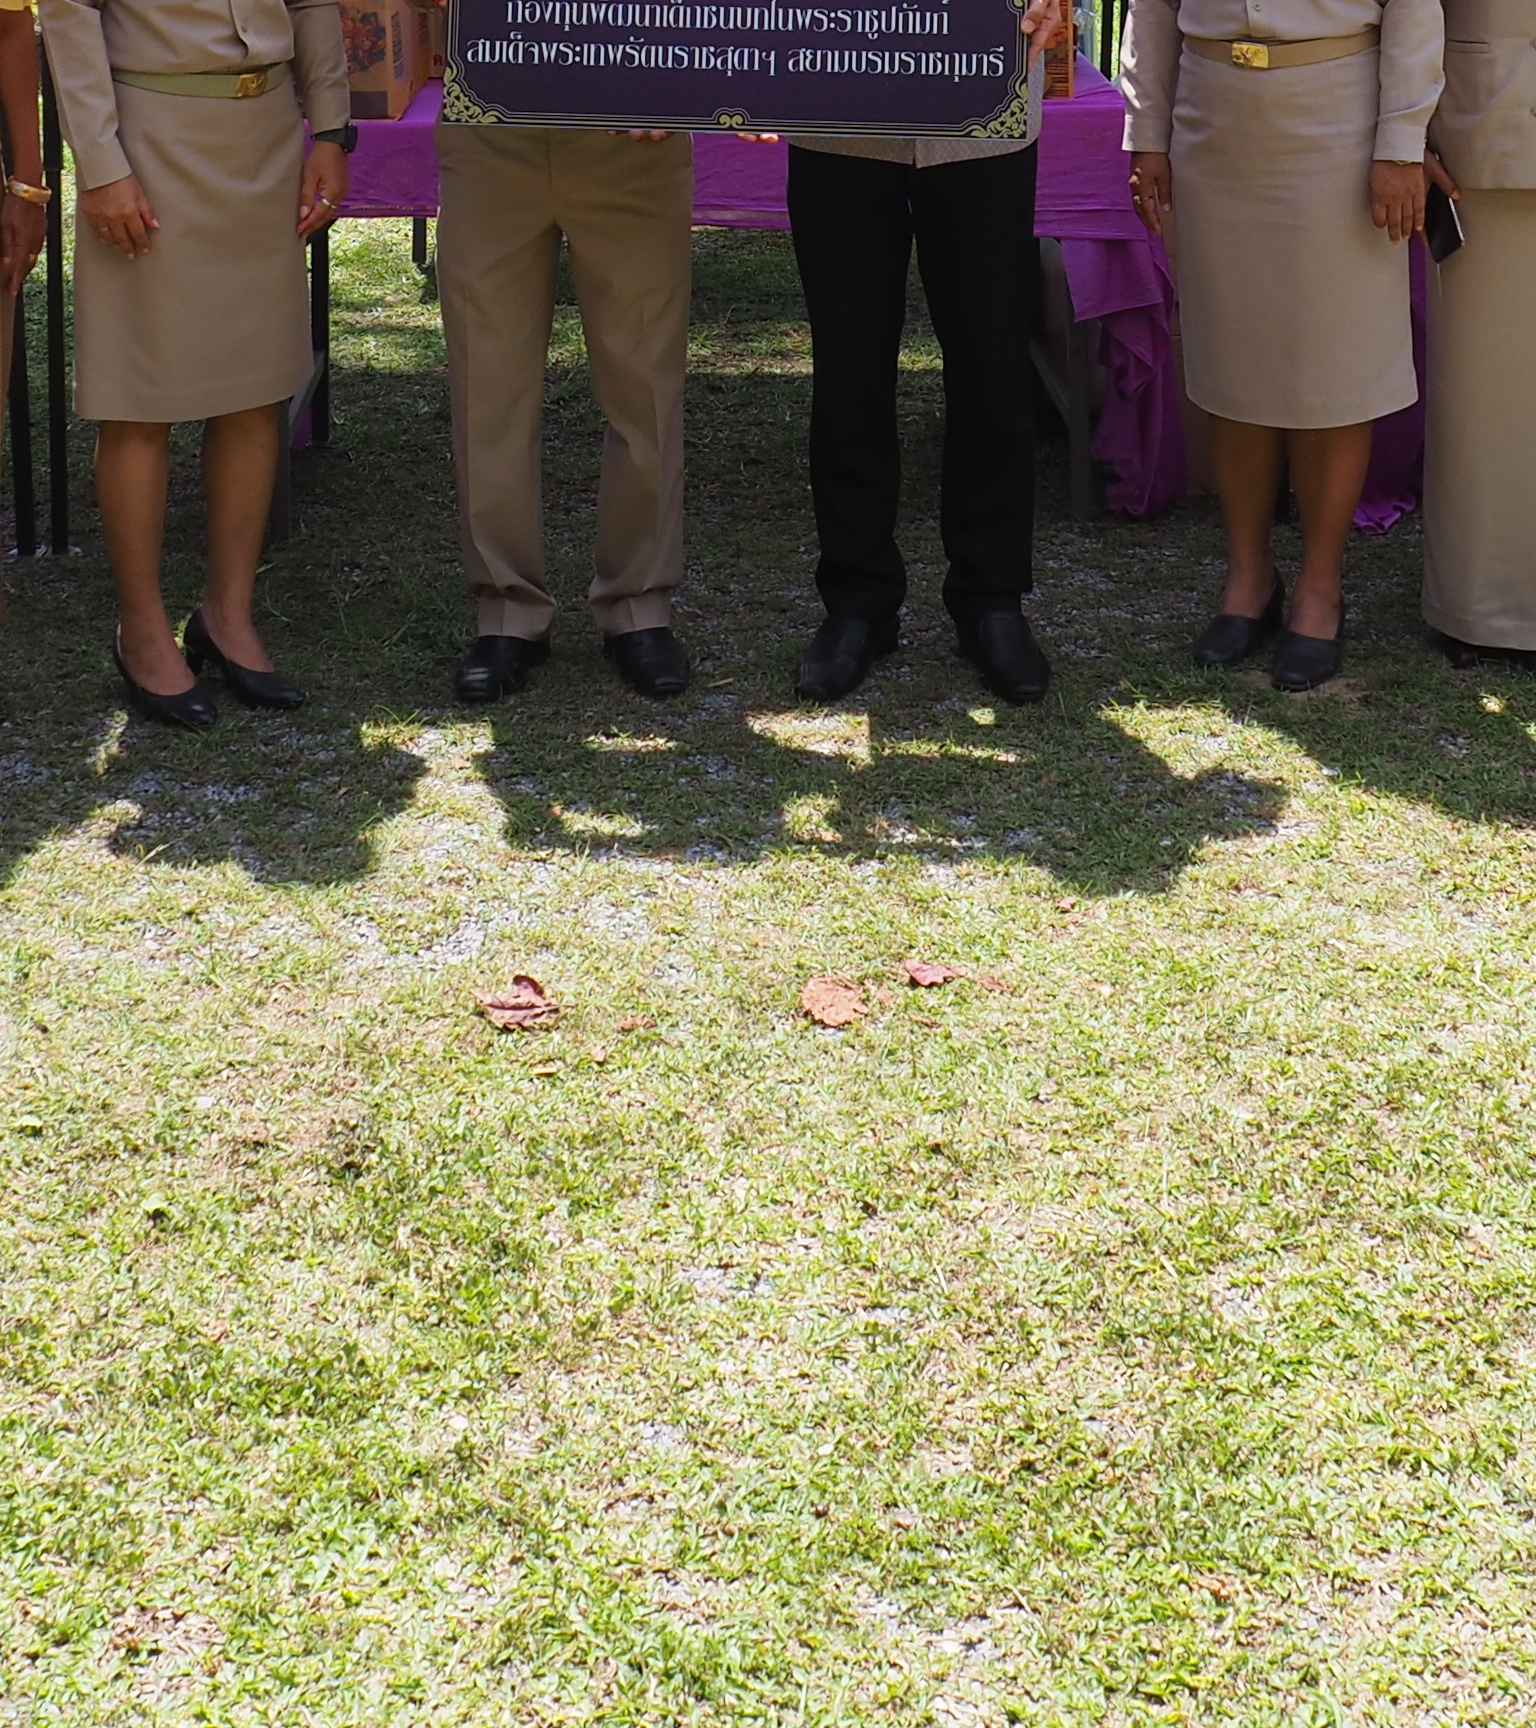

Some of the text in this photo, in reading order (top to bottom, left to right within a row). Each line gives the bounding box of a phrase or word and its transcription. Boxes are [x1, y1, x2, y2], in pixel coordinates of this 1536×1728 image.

[467, 30, 1005, 83] สมเด็จพระเทพรัตนราชสุดาฯ สยามบรมราชกุมารี
